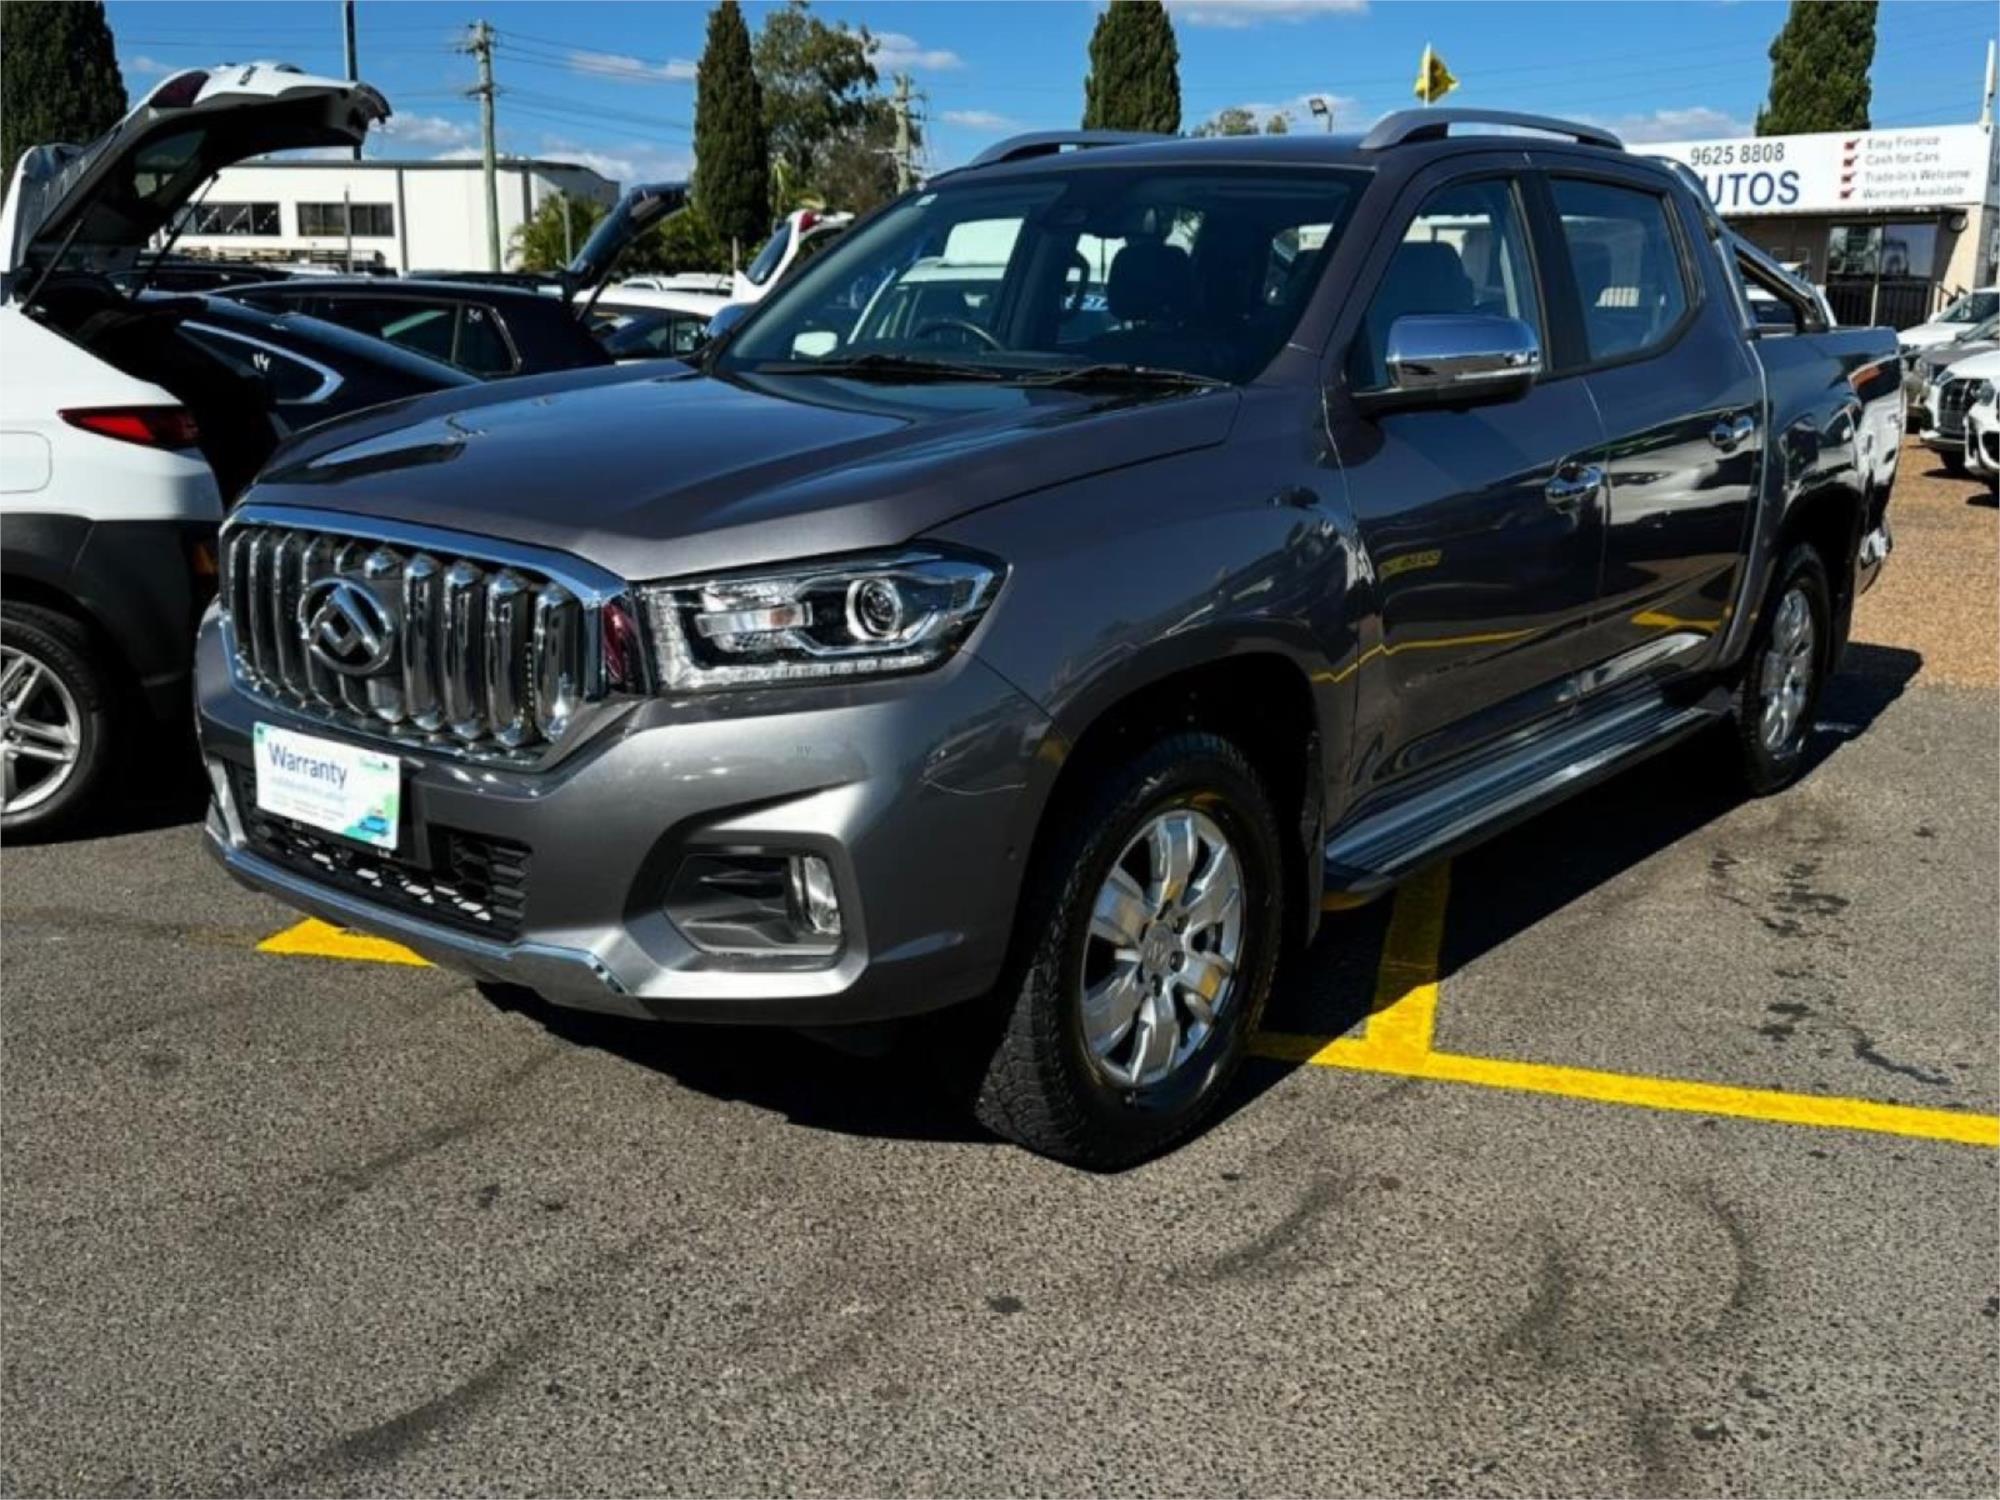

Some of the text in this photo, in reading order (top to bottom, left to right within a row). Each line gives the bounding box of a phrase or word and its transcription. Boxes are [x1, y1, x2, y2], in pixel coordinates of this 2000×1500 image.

[1896, 136, 1940, 147] Finance
[1690, 142, 1785, 166] 9625 8808
[1865, 152, 1939, 166] Cash for Cars
[1920, 169, 1970, 180] Welcome
[1703, 170, 1800, 206] UTOS
[1863, 186, 1965, 199] Warranty Available
[268, 741, 347, 789] Warranty
